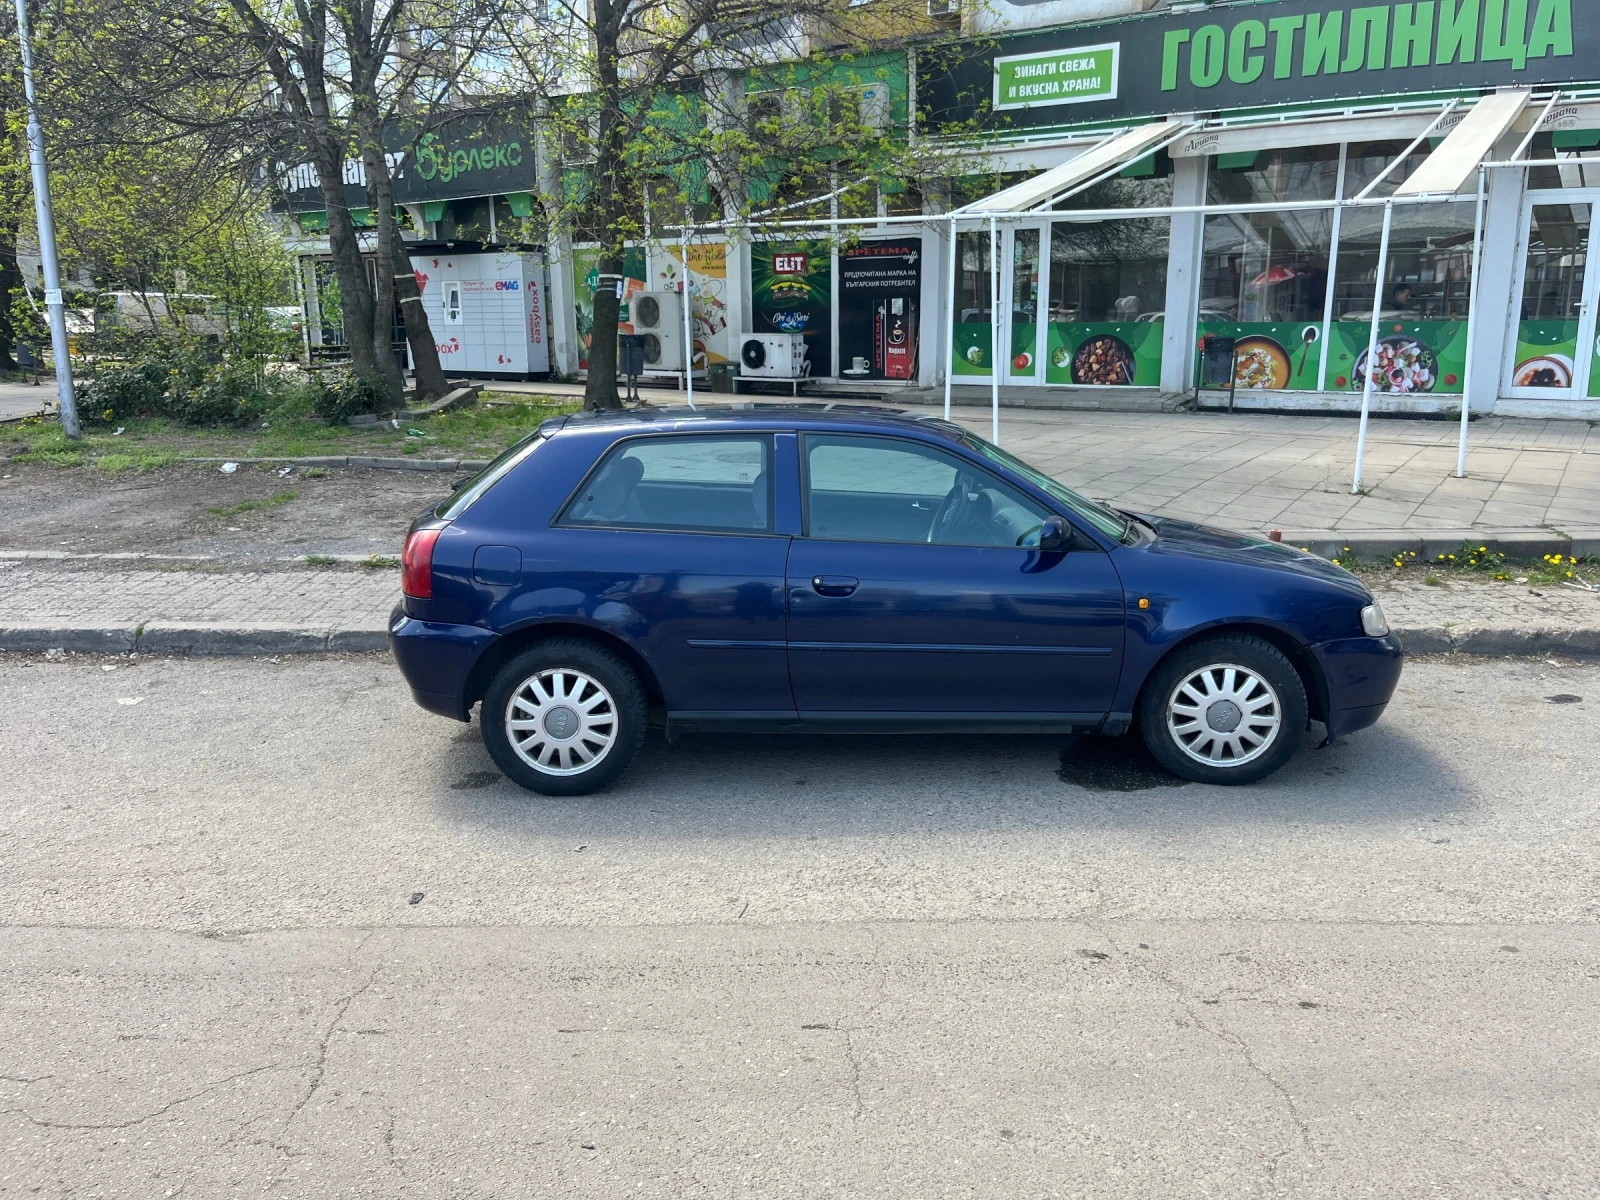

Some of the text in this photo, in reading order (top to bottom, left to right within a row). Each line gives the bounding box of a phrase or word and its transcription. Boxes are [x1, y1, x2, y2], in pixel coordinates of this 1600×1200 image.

[1160, 0, 1574, 92] ГОСТИЛНИЦА
[1059, 57, 1096, 73] СВЕЖА
[1008, 76, 1101, 98] И ВКУСНА ХРАНА!
[1185, 134, 1219, 152] Ариана
[844, 270, 887, 279] ПРЕДПОЧИТАНА
[880, 279, 916, 287] ПОТРЕБИТЕЛ
[494, 280, 519, 291] eMAG
[532, 289, 542, 344] easybox
